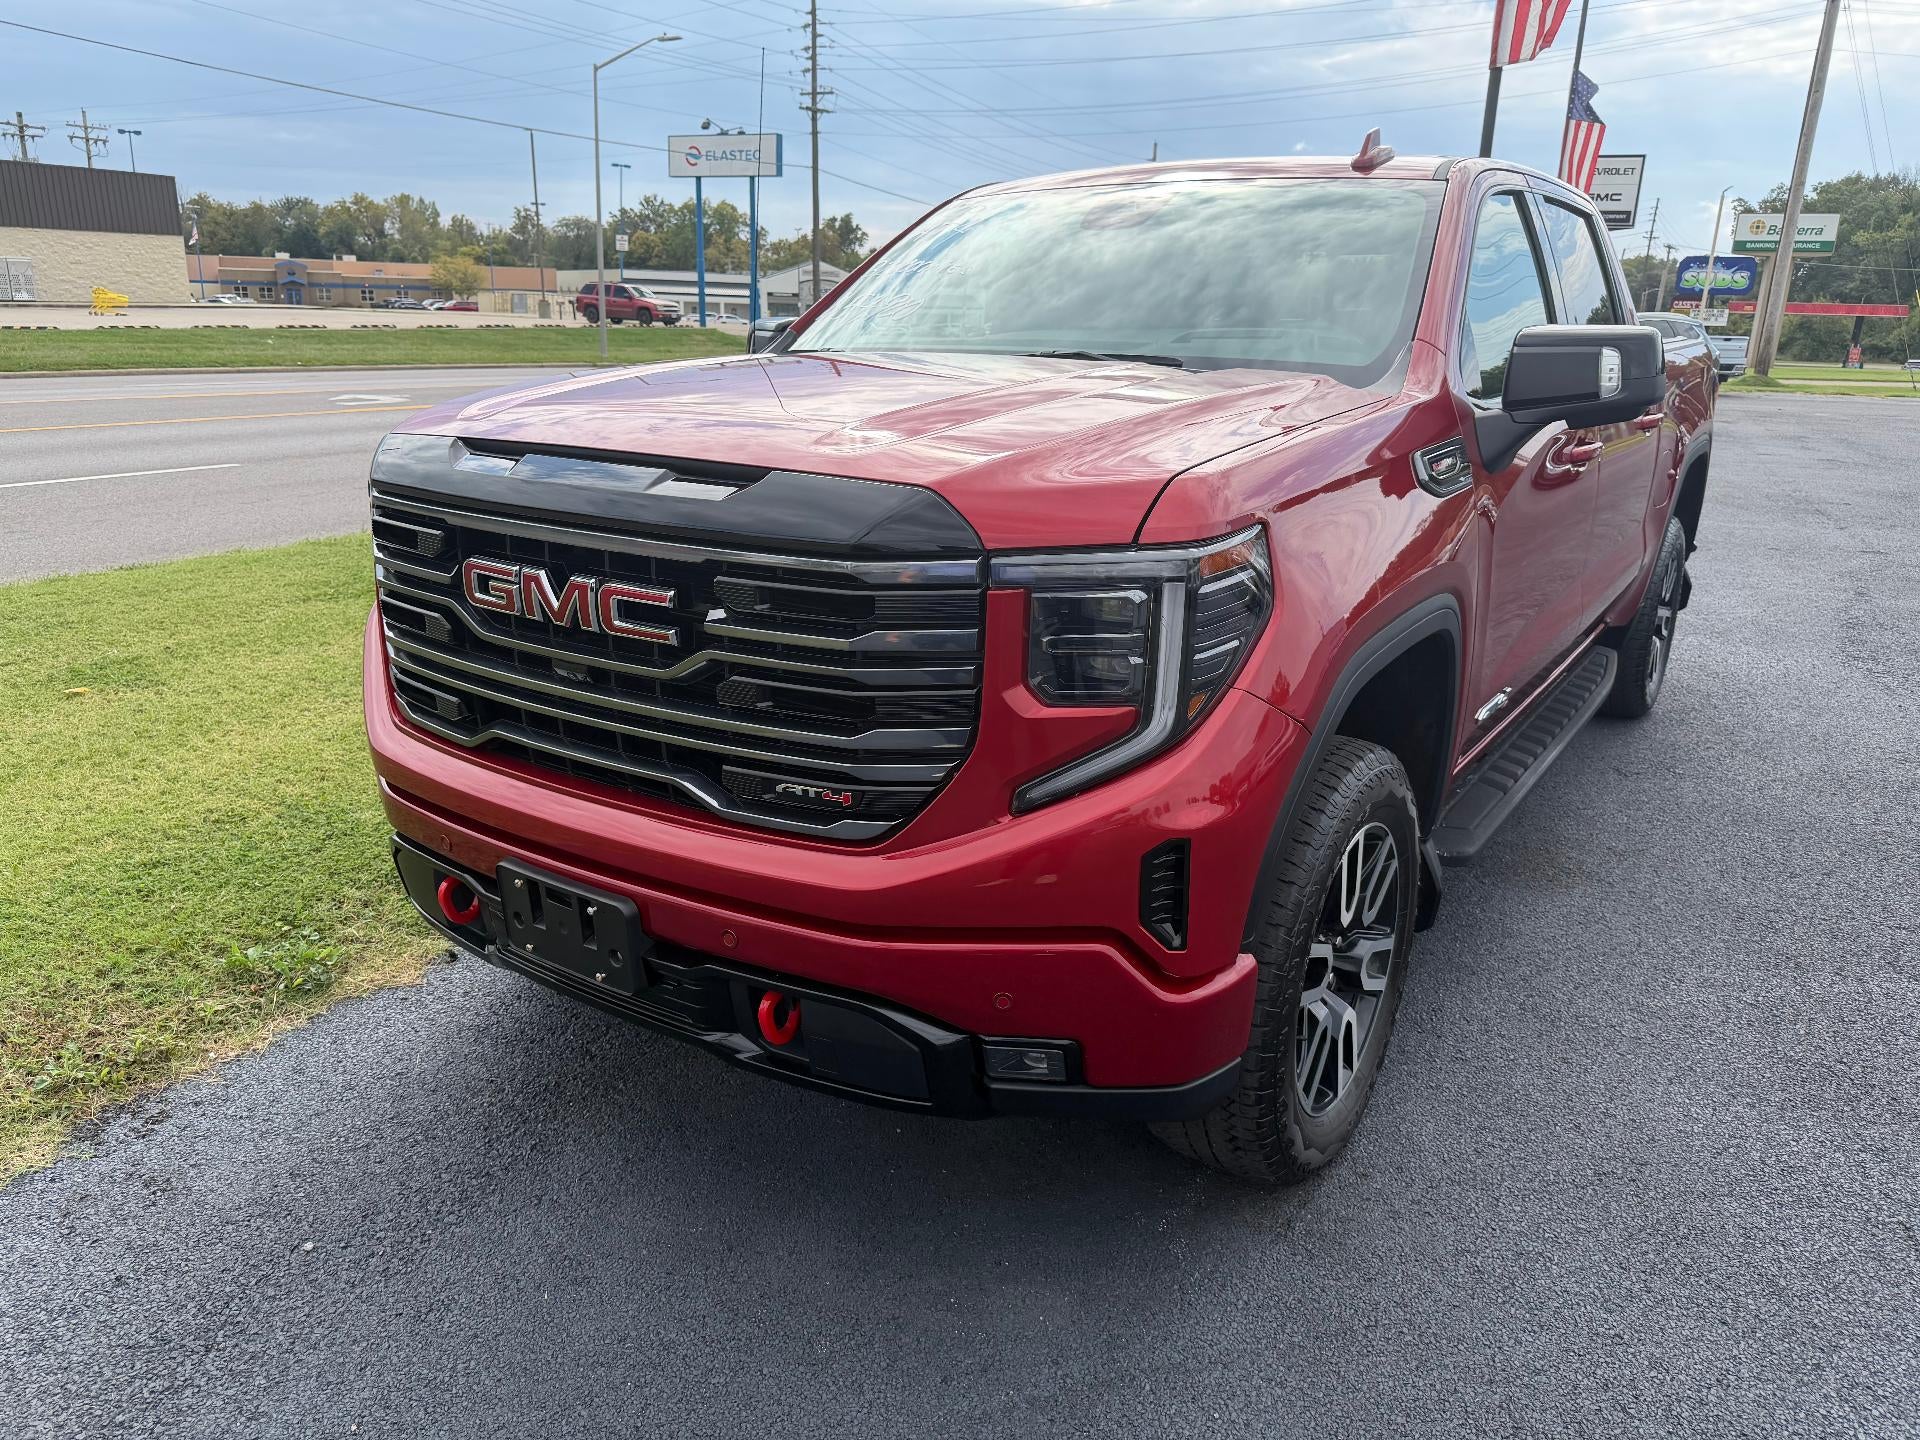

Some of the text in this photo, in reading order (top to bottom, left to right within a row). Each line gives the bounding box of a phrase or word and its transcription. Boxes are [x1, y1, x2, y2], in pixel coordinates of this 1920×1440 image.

[705, 149, 760, 161] ELASTEC
[1766, 224, 1824, 236] Baerra
[1681, 271, 1750, 289] SUDS
[462, 555, 680, 647] GMC
[775, 783, 852, 807] AT4
